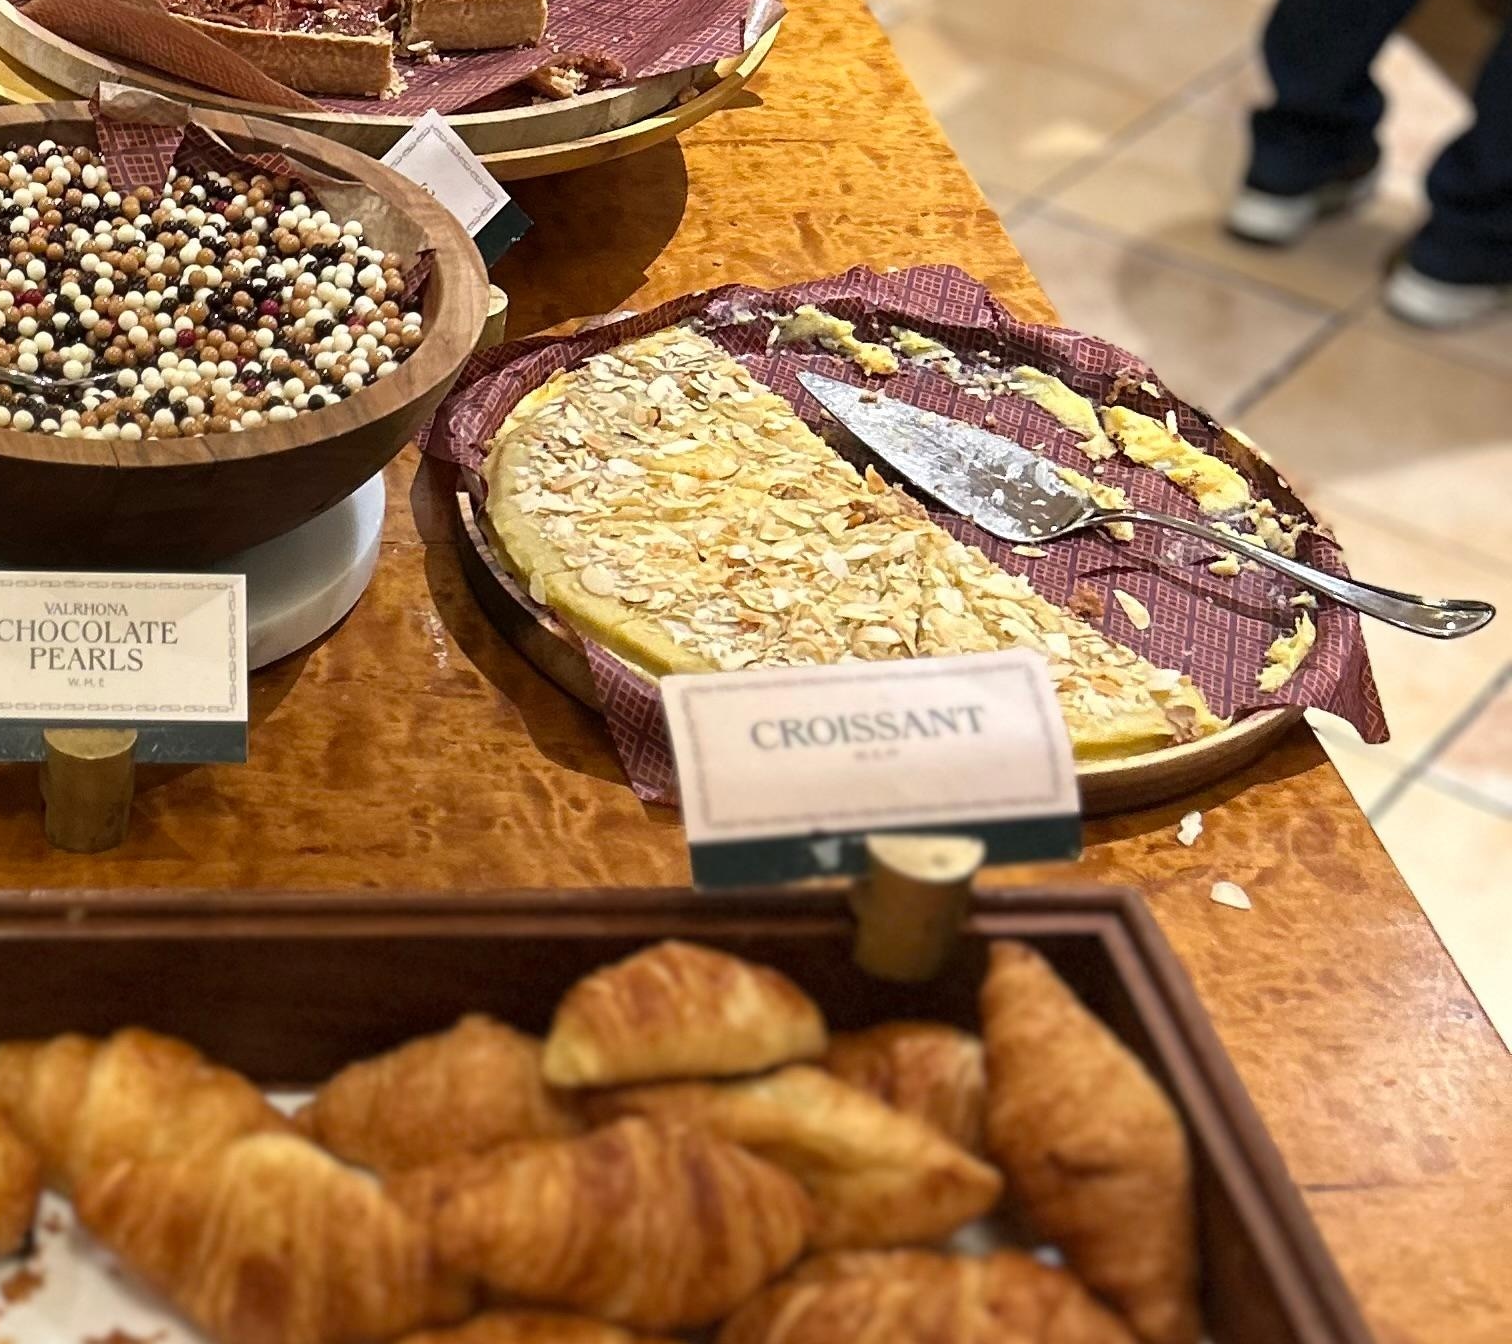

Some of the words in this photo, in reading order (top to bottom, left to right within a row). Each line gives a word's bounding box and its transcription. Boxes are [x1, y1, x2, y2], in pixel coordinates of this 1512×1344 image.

[44, 601, 128, 617] VALRHONA
[29, 647, 144, 672] PEARLS
[750, 705, 985, 752] CROISSANT
